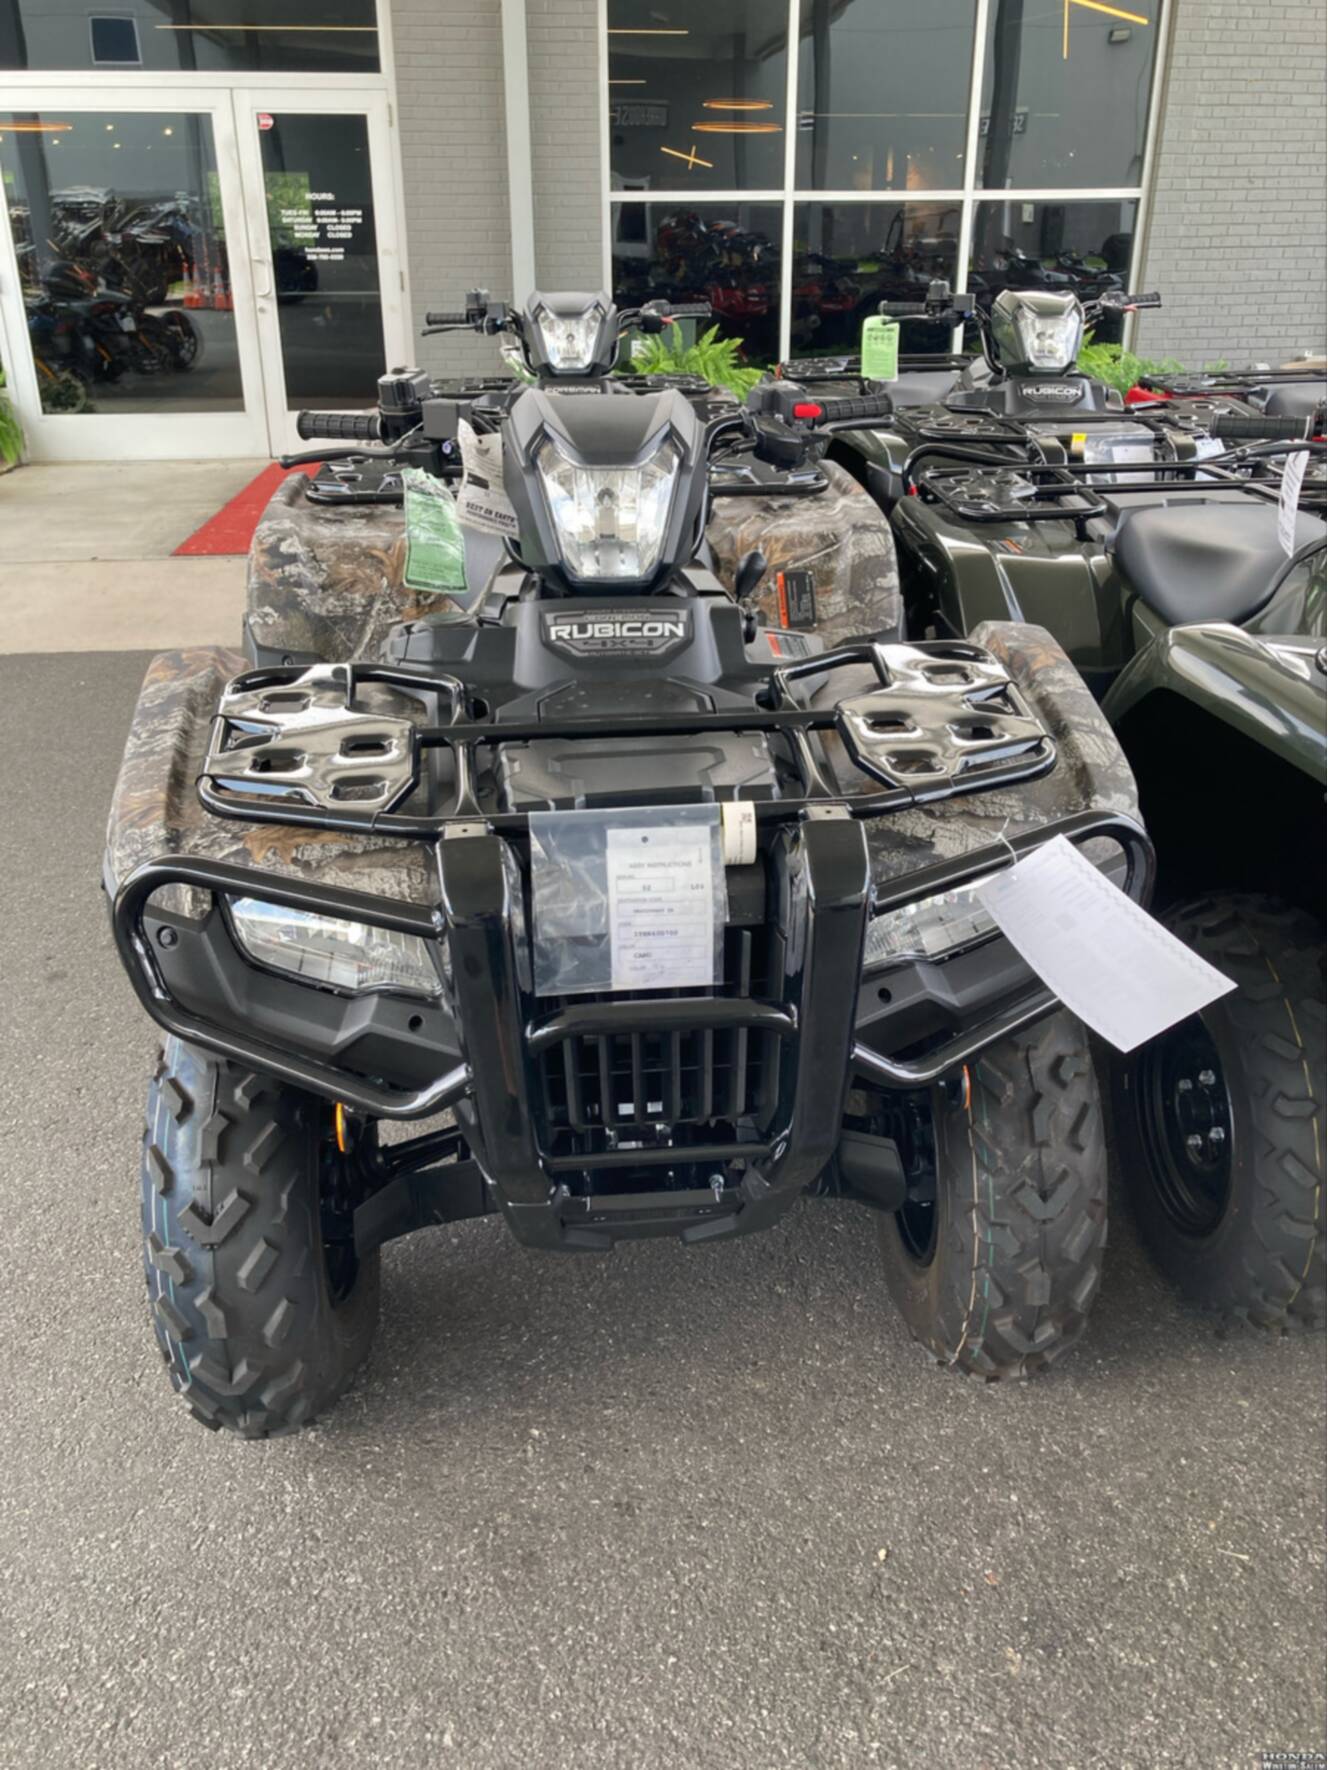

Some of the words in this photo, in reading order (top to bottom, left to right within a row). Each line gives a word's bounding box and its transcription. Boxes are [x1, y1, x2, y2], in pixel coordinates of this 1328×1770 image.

[305, 192, 336, 201] HOURS:
[326, 231, 353, 239] CLOSED
[1022, 387, 1082, 396] RUBICON
[550, 622, 684, 641] RUBICON
